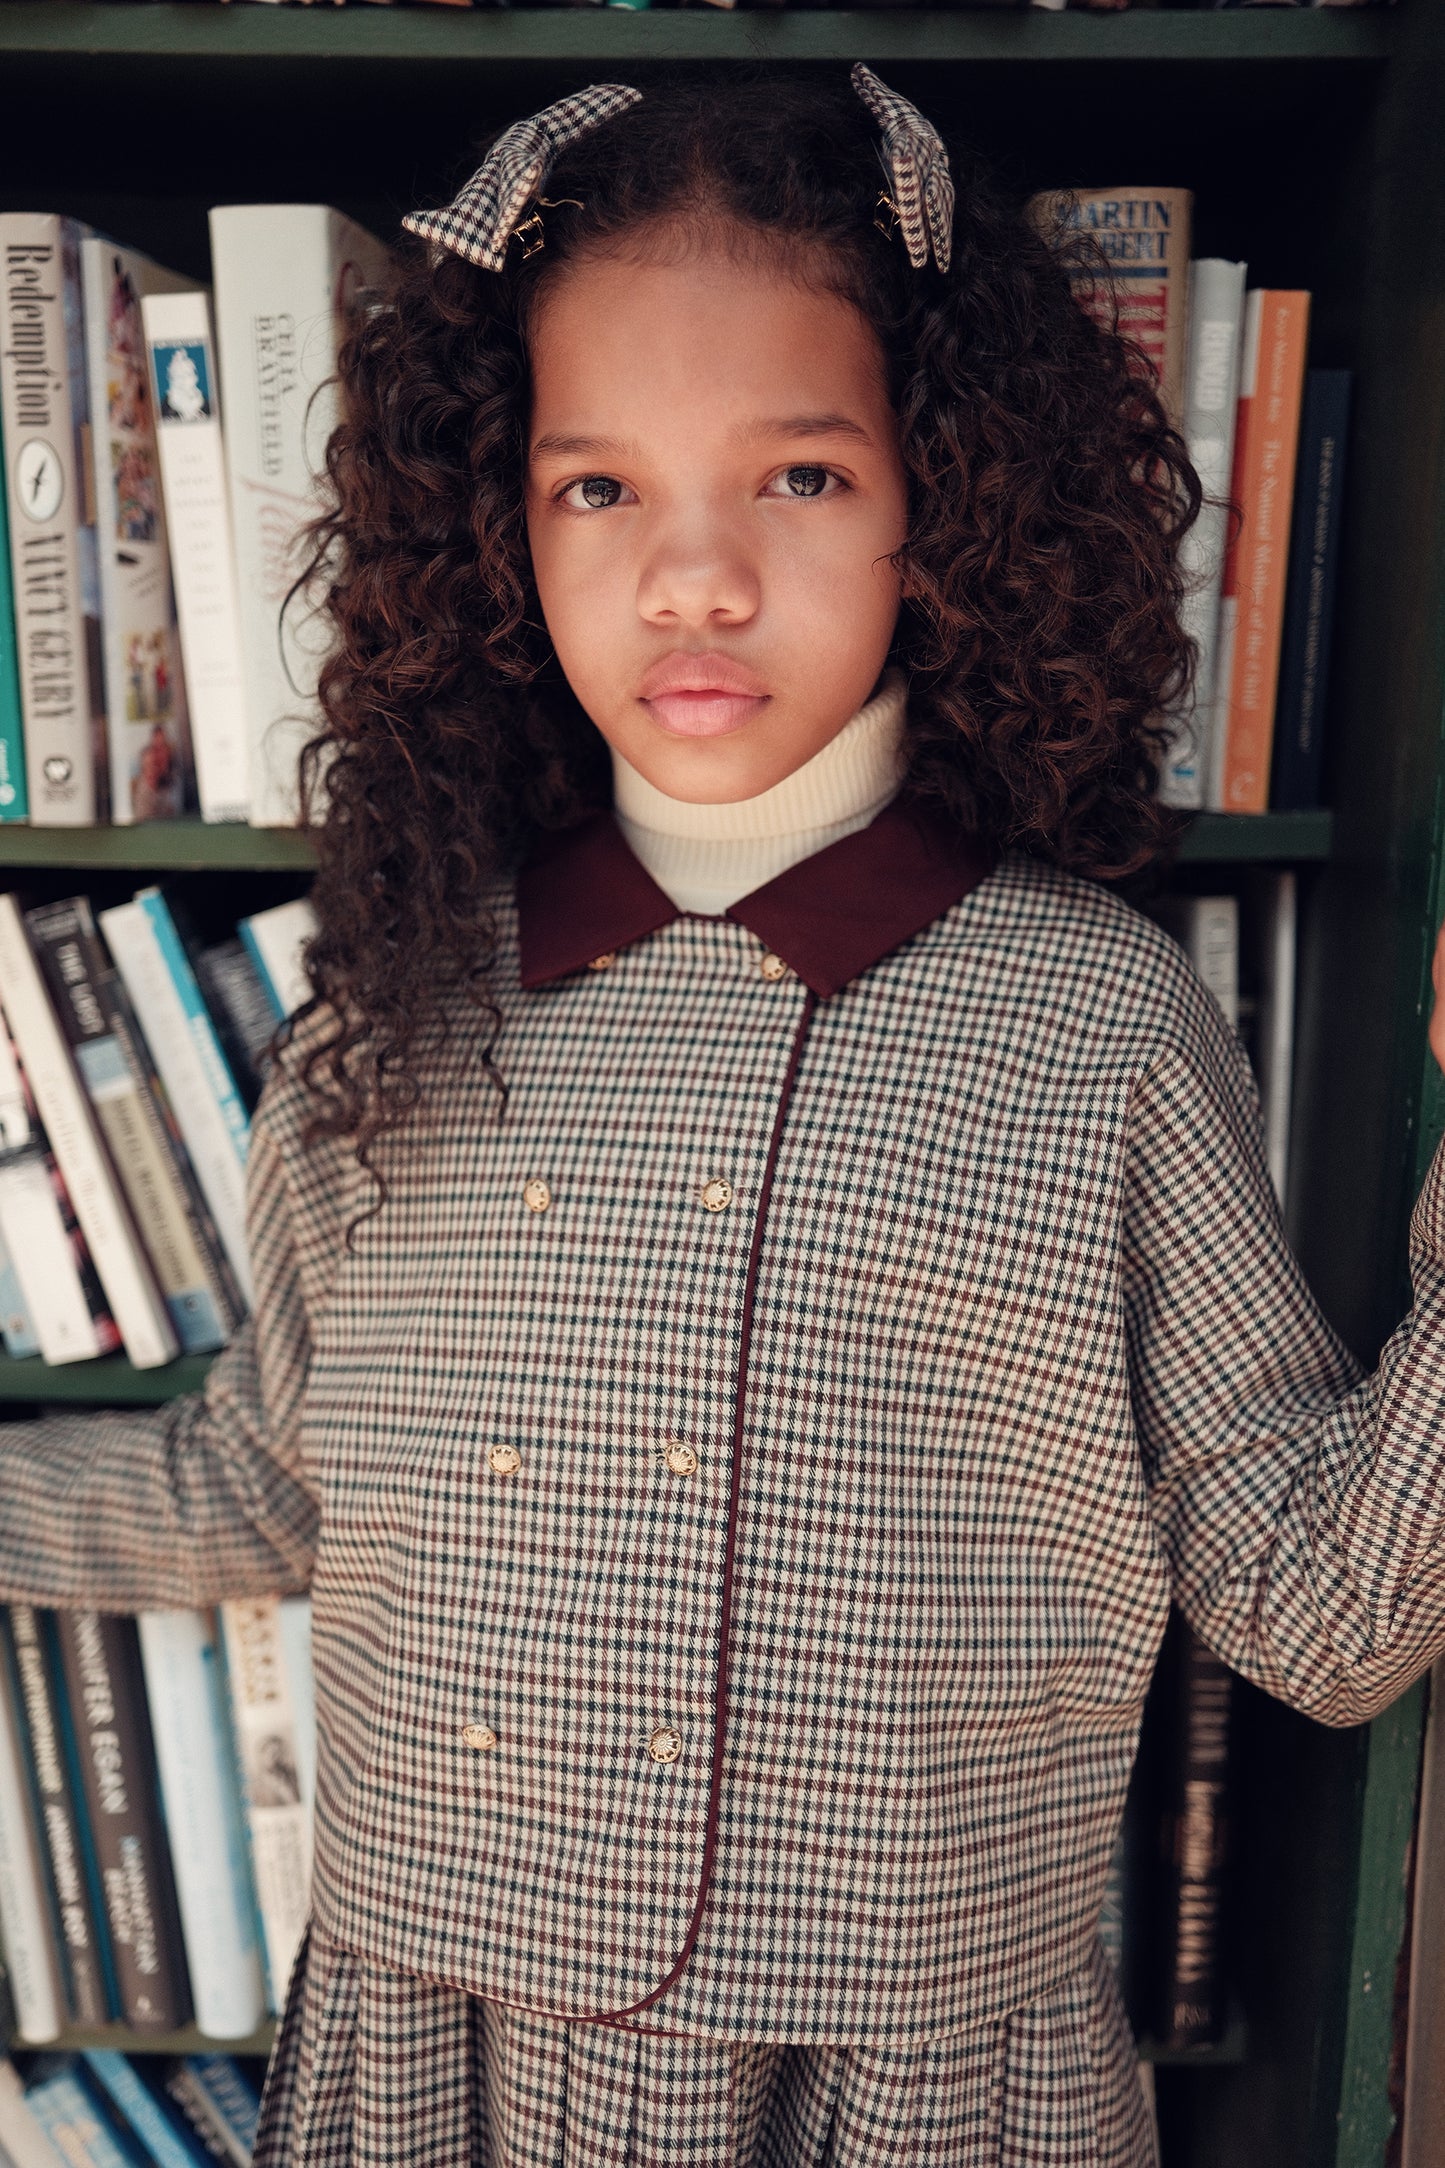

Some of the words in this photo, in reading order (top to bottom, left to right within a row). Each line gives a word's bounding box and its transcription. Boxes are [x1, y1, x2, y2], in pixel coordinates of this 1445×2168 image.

[1057, 200, 1172, 229] MARTIN
[5, 245, 61, 427] Redemption
[275, 313, 297, 394] CELIA
[255, 314, 282, 476] BRAYFIELD
[1262, 440, 1281, 473] The
[1257, 475, 1278, 540] Natural
[24, 534, 67, 615] NANCY
[1253, 544, 1273, 605] Mother
[1247, 631, 1262, 657] the
[1250, 608, 1265, 629] of
[28, 630, 74, 717] GEARY
[1242, 660, 1260, 711] Child
[56, 942, 87, 986] THE
[69, 982, 105, 1034] LOST
[72, 1610, 115, 1726] NNIFER
[89, 1729, 129, 1814] EGAN
[103, 1866, 132, 1943] BEACH
[119, 1834, 160, 1975] MANHATTAN
